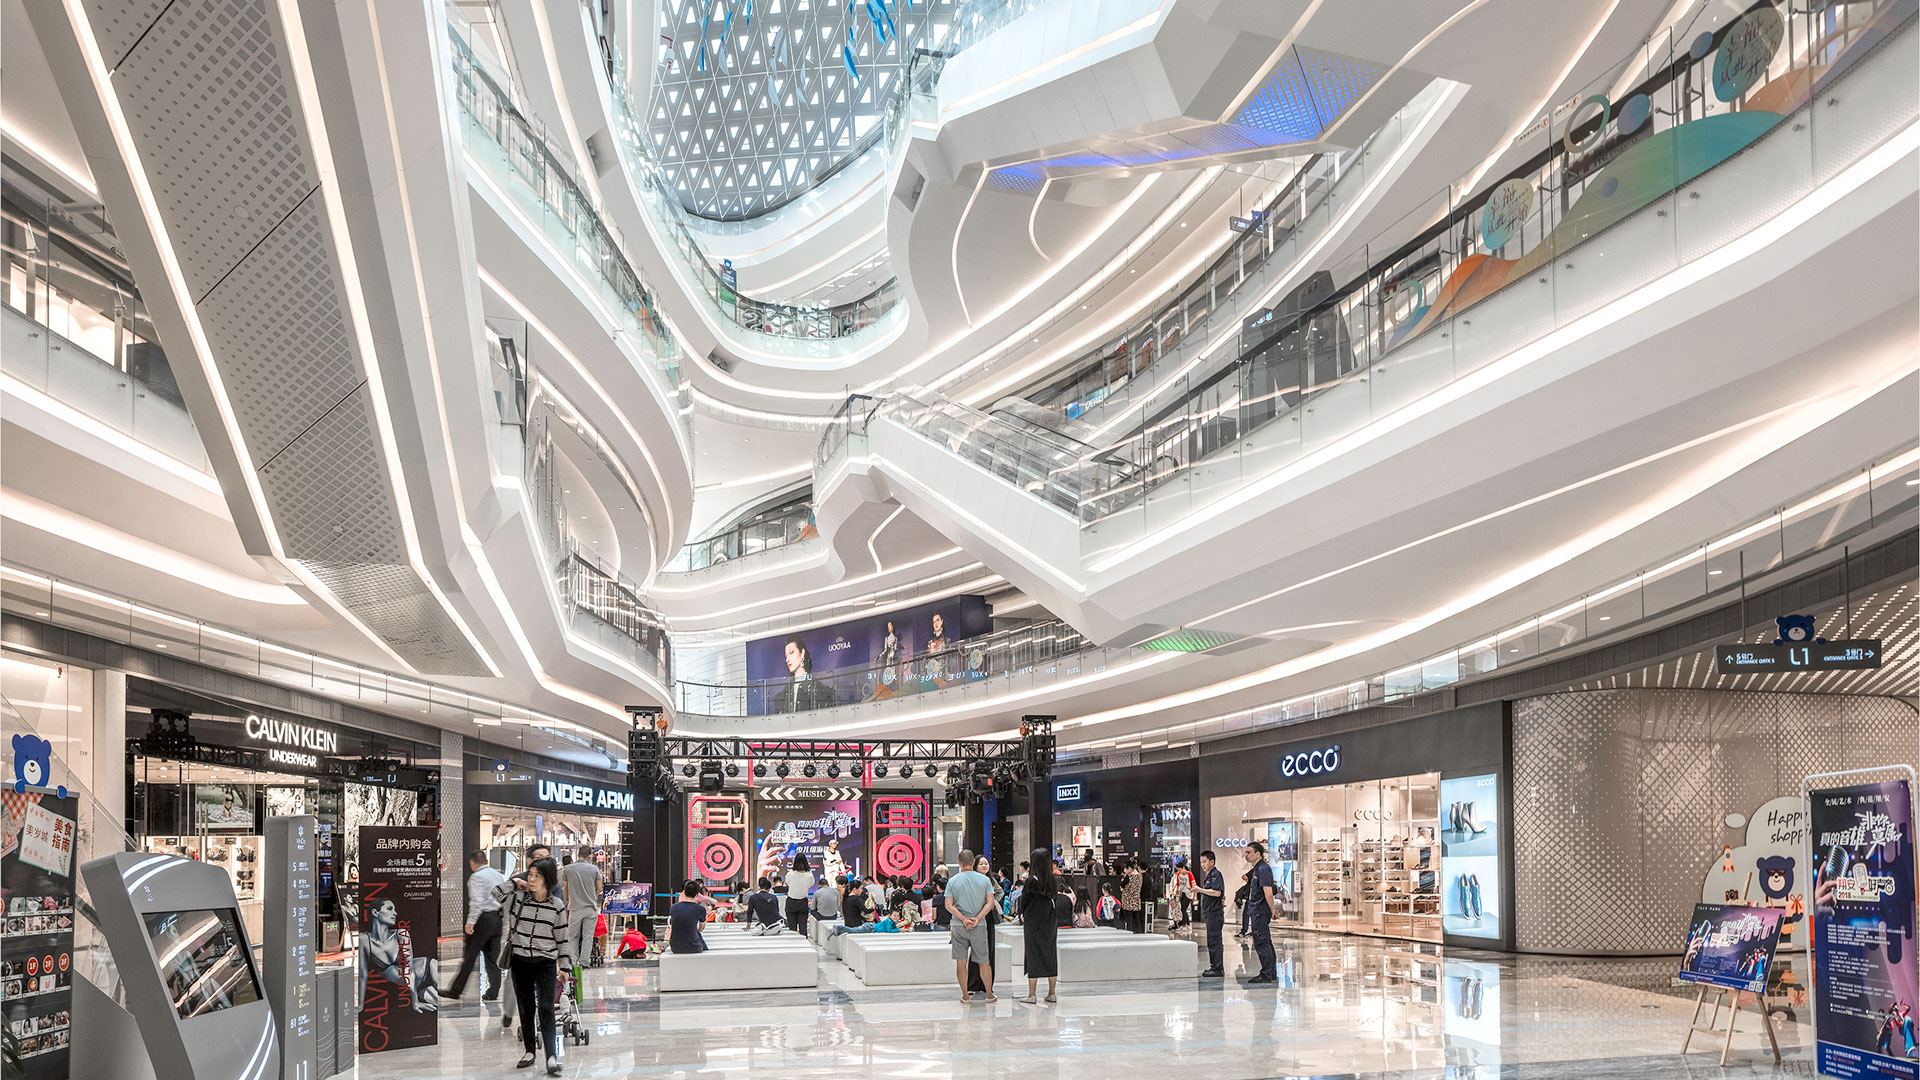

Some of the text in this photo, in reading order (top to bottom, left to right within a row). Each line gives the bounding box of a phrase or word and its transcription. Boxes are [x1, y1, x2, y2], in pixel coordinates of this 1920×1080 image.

[828, 642, 852, 652] UOOYAA
[1790, 647, 1809, 666] L1
[245, 715, 337, 753] CALVIN KLEIN
[269, 749, 317, 768] UNDERWEAR
[496, 773, 505, 782] L1
[1476, 778, 1495, 788] ecco
[538, 779, 594, 806] UNDER
[797, 790, 826, 798] MUSIC
[1059, 787, 1078, 798] INXX
[1161, 808, 1191, 821] INXX
[1353, 808, 1392, 822] ecco
[54, 817, 73, 838] 美食
[51, 833, 71, 854] 指南
[376, 838, 433, 850] 品牌内购会
[1216, 837, 1248, 848] ecco
[415, 853, 426, 867] 5
[292, 861, 297, 872] 5
[292, 907, 297, 917] 3
[29, 962, 37, 970] 1F
[44, 960, 52, 968] 2F
[398, 919, 411, 1008] UNDERWEAR
